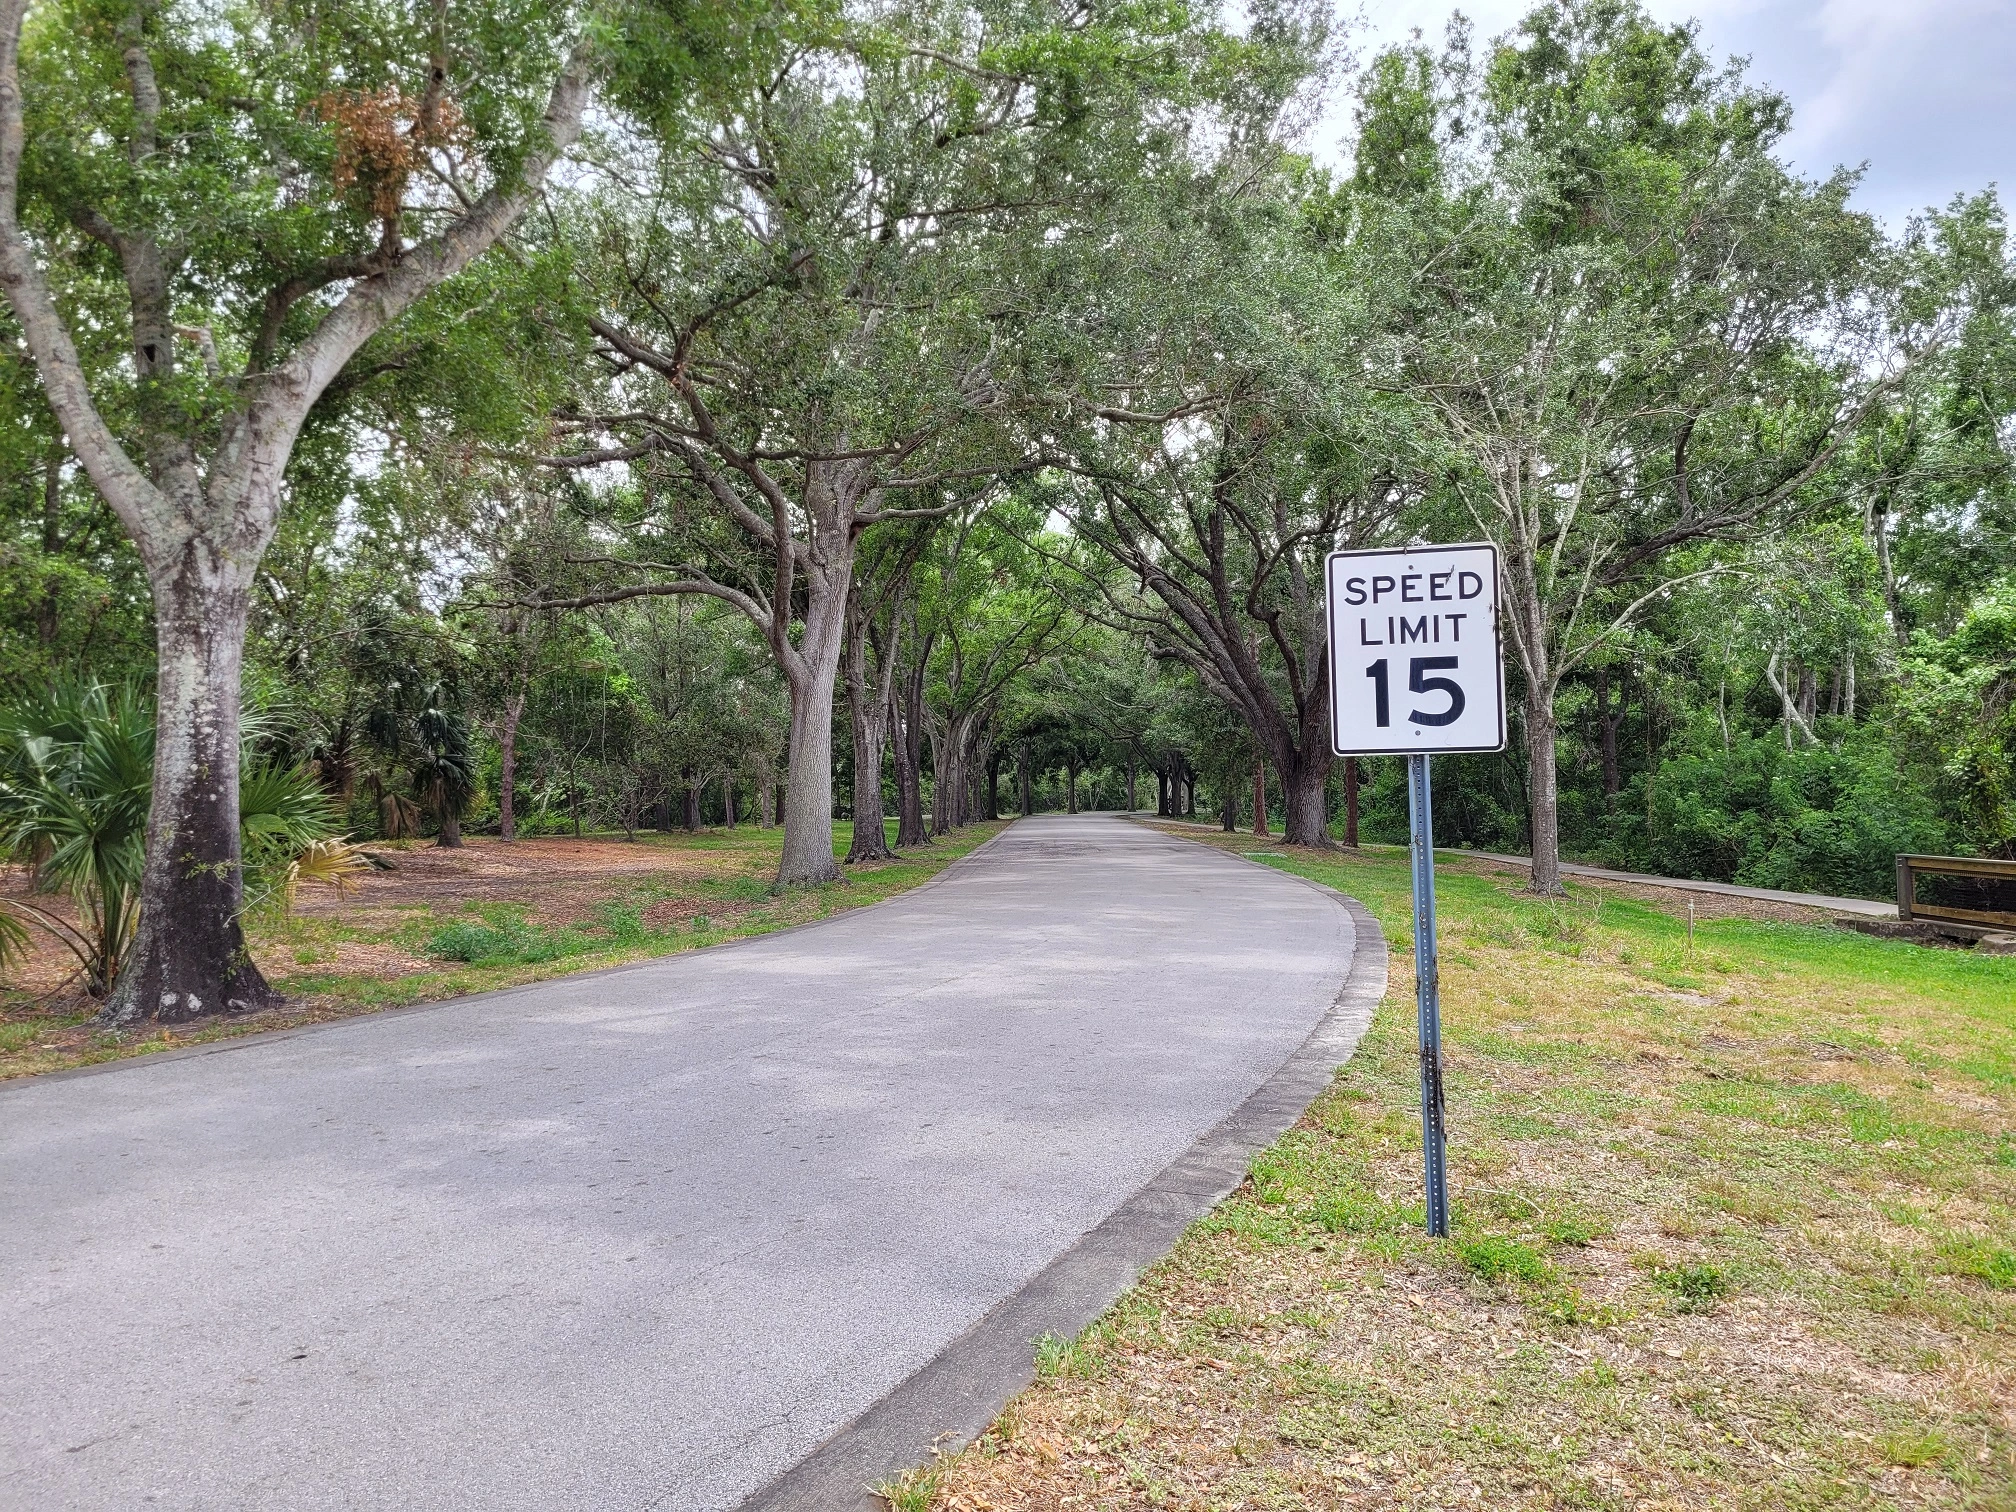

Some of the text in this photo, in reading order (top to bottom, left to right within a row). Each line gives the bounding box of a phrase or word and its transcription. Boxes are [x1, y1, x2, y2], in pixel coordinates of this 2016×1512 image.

[1344, 571, 1483, 606] SPEED
[1360, 613, 1467, 646] LIMIT
[1365, 655, 1466, 728] 15
